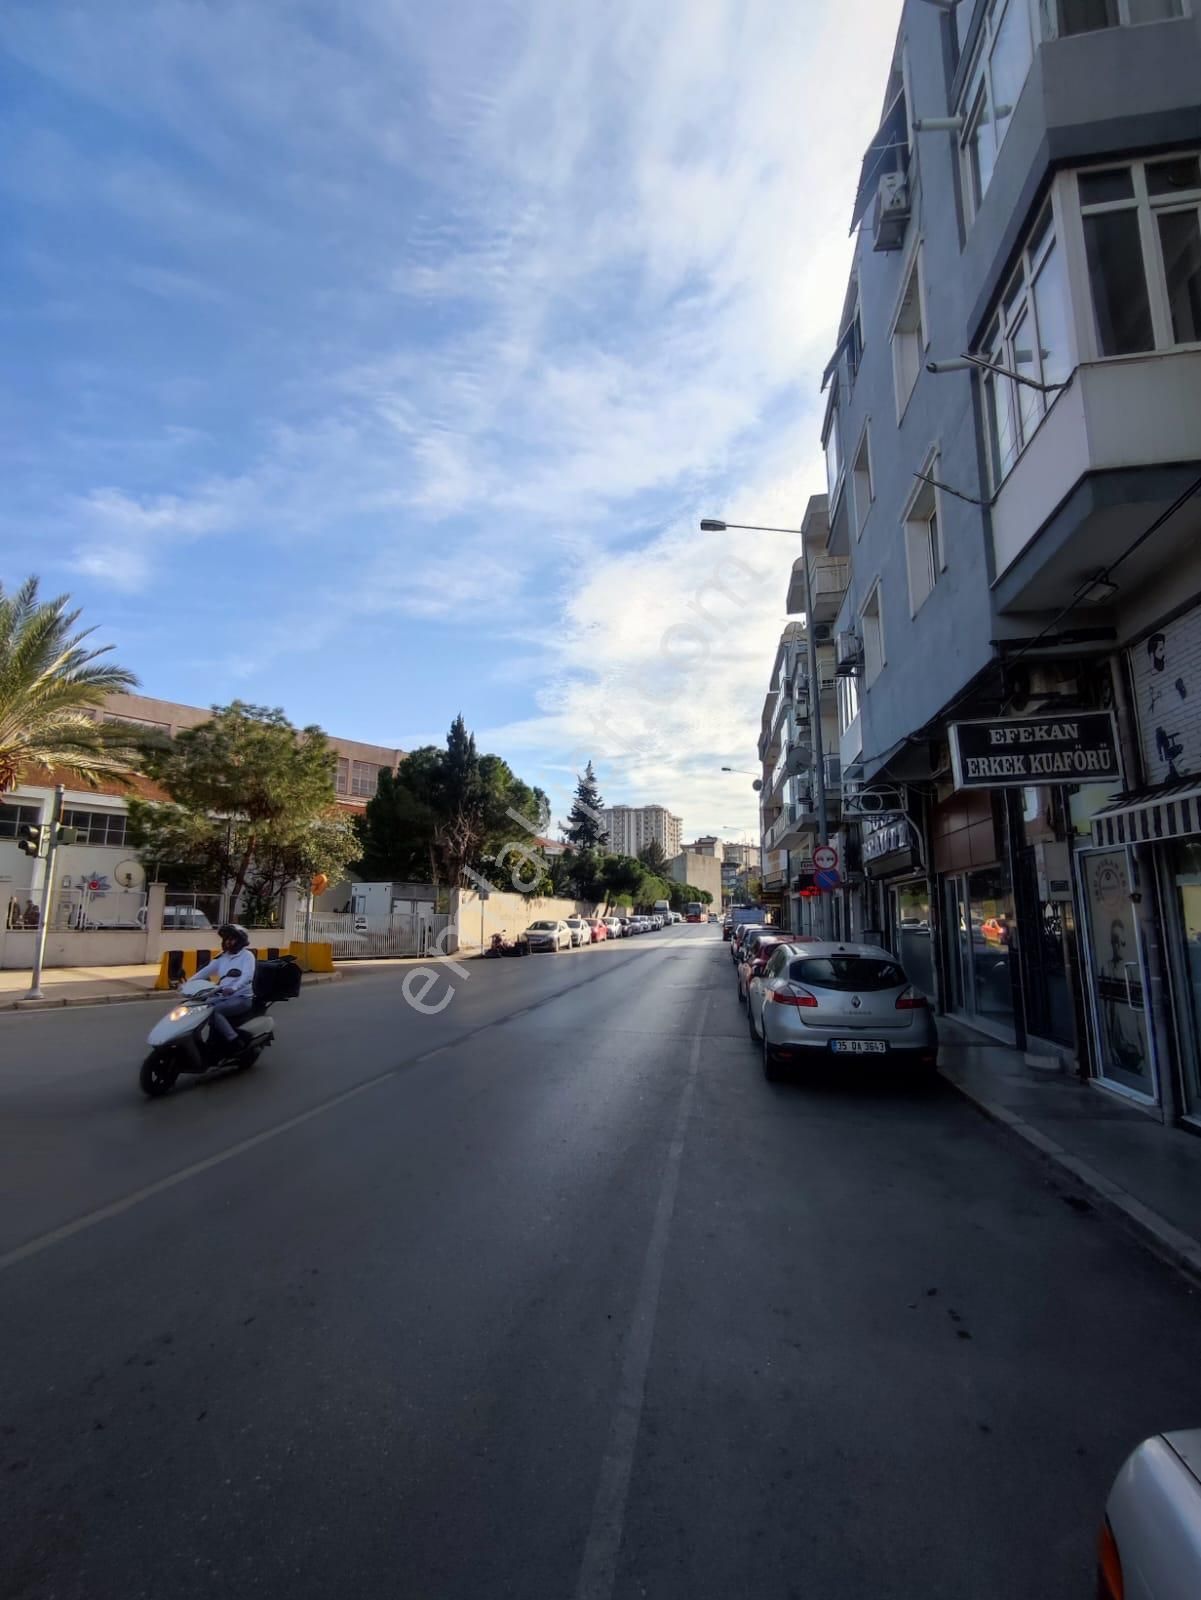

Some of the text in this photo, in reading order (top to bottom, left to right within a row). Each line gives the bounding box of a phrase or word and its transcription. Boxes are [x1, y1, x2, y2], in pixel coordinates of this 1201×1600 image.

[989, 723, 1079, 745] EFEKAN
[966, 743, 1110, 778] ERKEK KUAFÖRÜ
